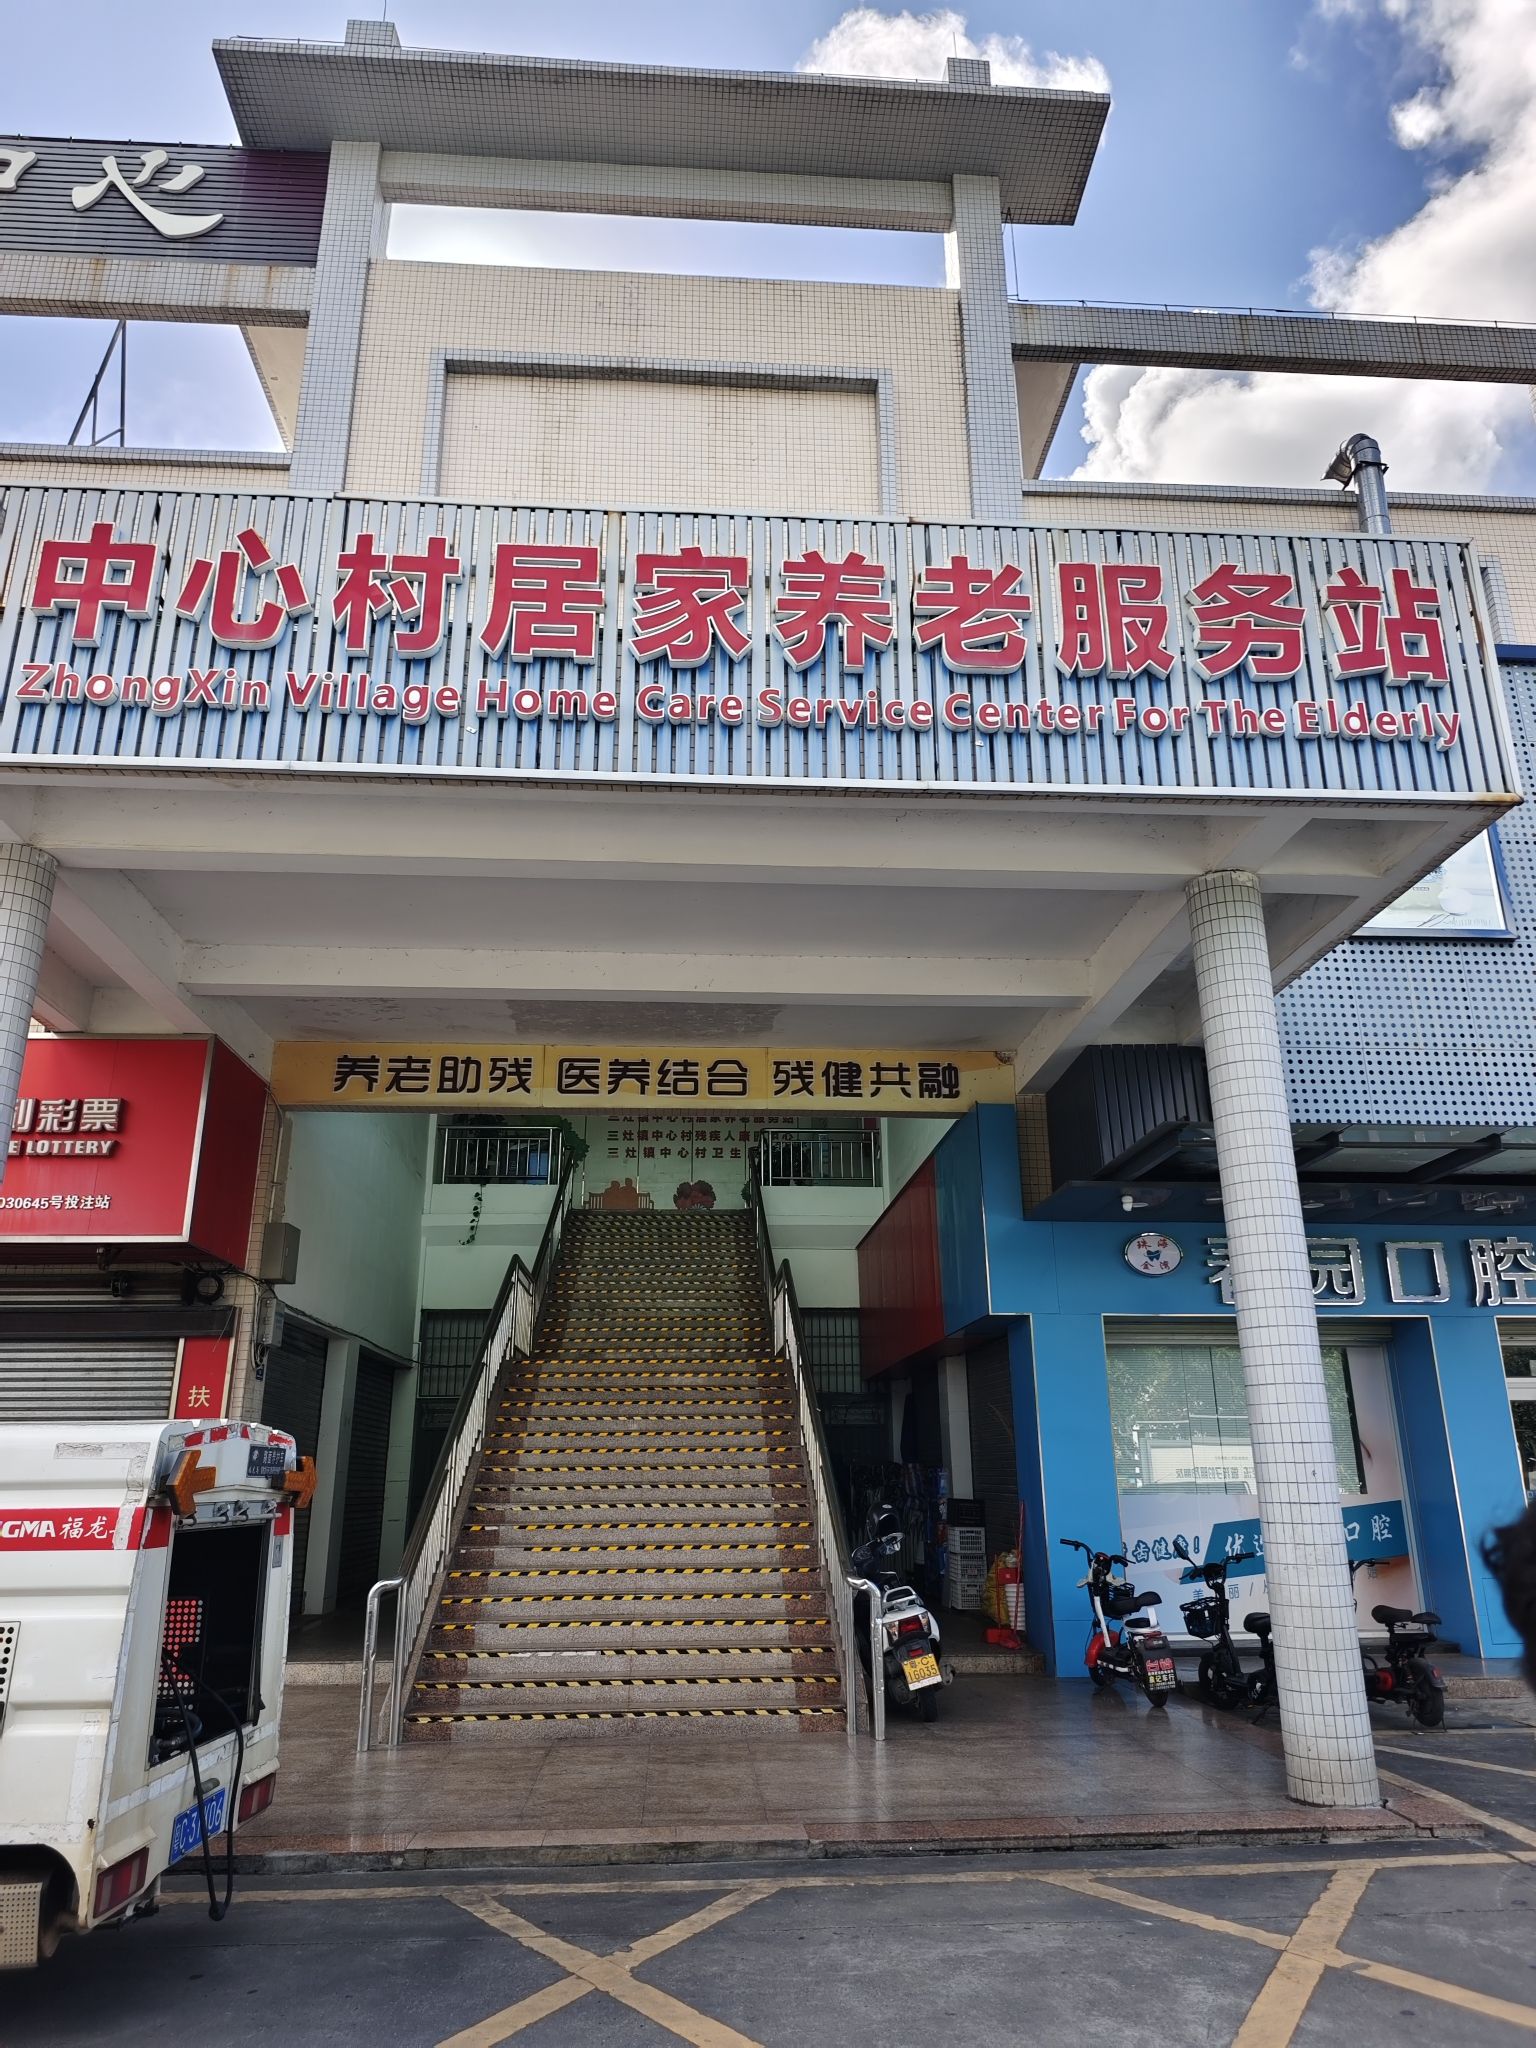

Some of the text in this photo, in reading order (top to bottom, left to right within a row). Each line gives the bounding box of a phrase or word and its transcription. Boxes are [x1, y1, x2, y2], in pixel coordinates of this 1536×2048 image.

[30, 521, 1450, 688] 中心村居家养老服务站
[15, 661, 1462, 752] ZhongXin Village Home Care Service Center For The Elderly
[333, 1054, 961, 1099] 养老助残 医养结合 残健共融
[26, 1139, 113, 1155] LOTTERY
[188, 1385, 210, 1408] 扶
[60, 1516, 116, 1540] 福龙
[908, 1664, 938, 1682] 16035
